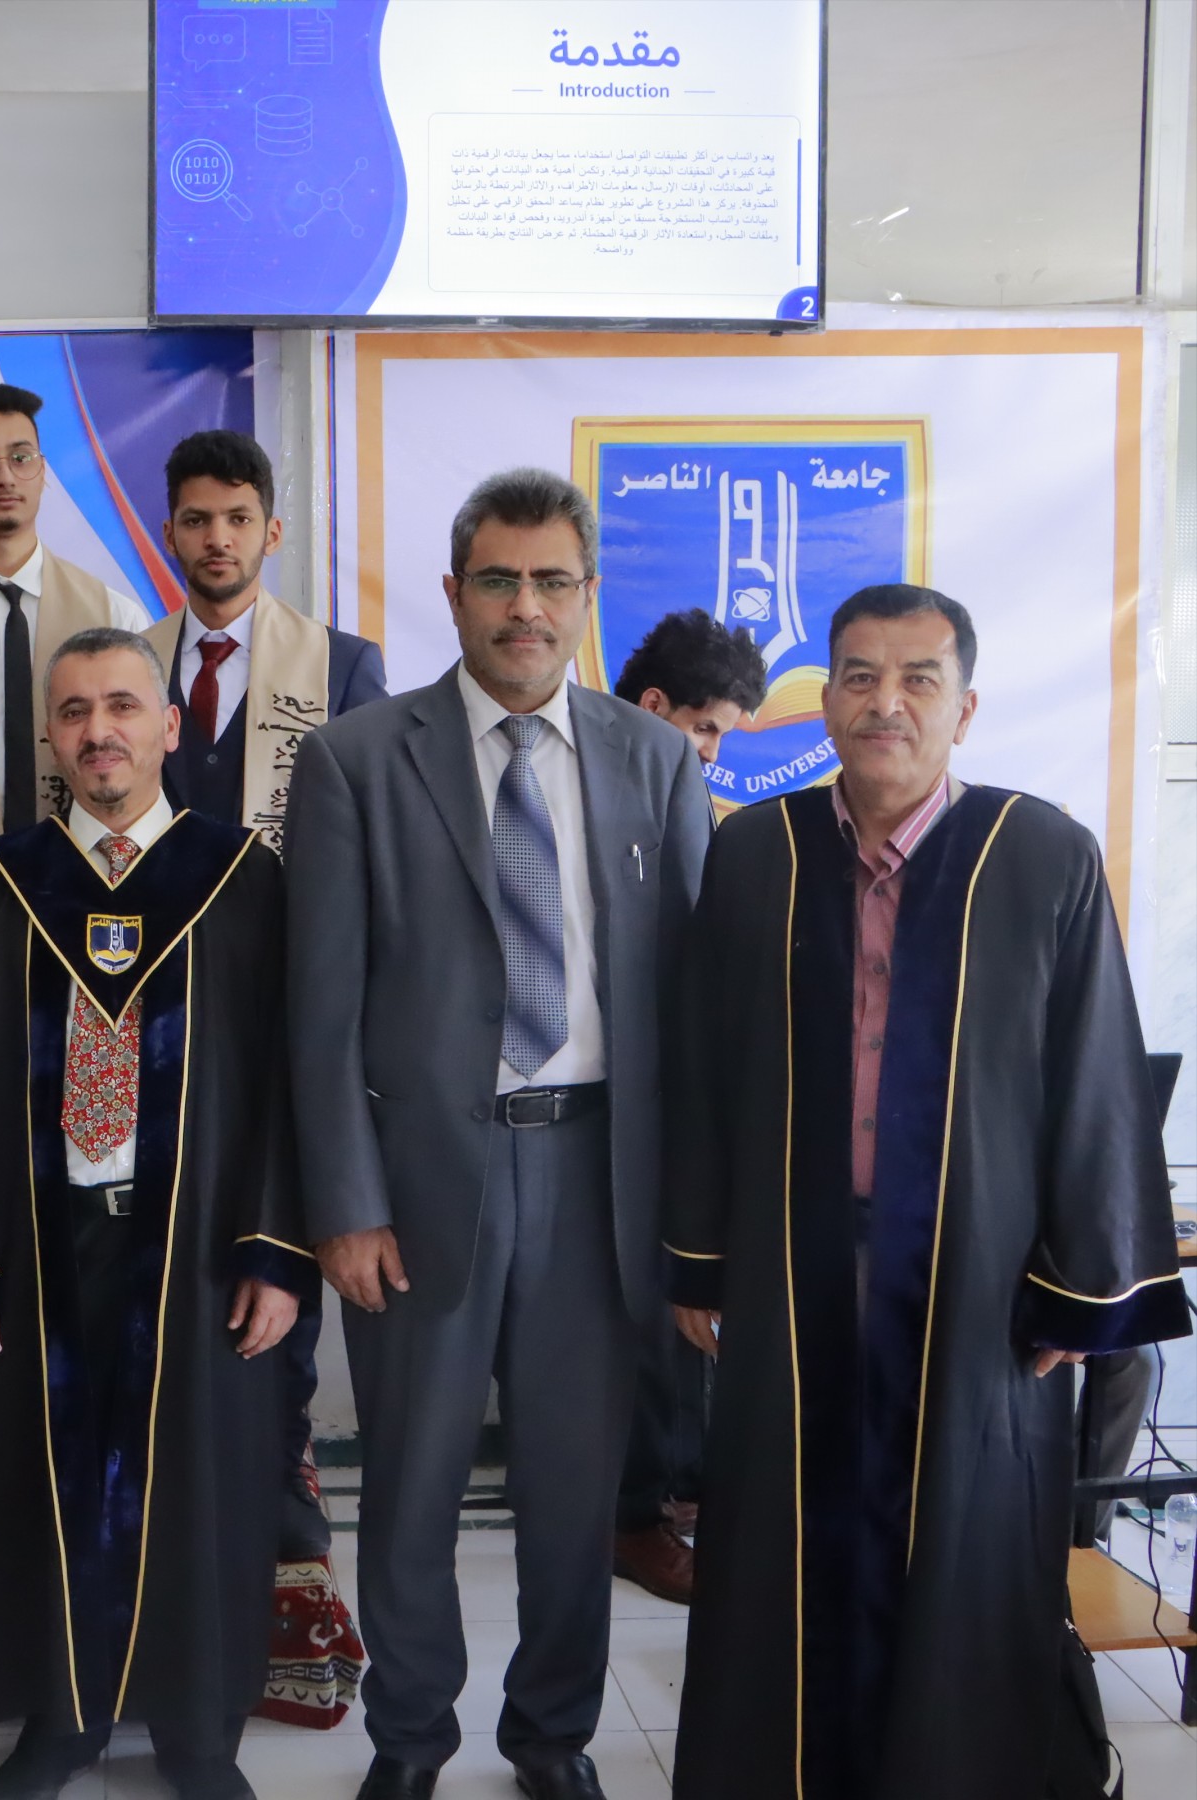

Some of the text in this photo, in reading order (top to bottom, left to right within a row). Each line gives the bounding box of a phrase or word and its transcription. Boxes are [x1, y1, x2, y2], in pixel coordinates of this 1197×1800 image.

[550, 29, 680, 67] مقدمة
[559, 82, 670, 98] Introduction
[185, 156, 219, 169] 1010
[184, 173, 219, 185] 0101
[801, 296, 815, 316] 2
[612, 457, 891, 497] جامعة الناصر
